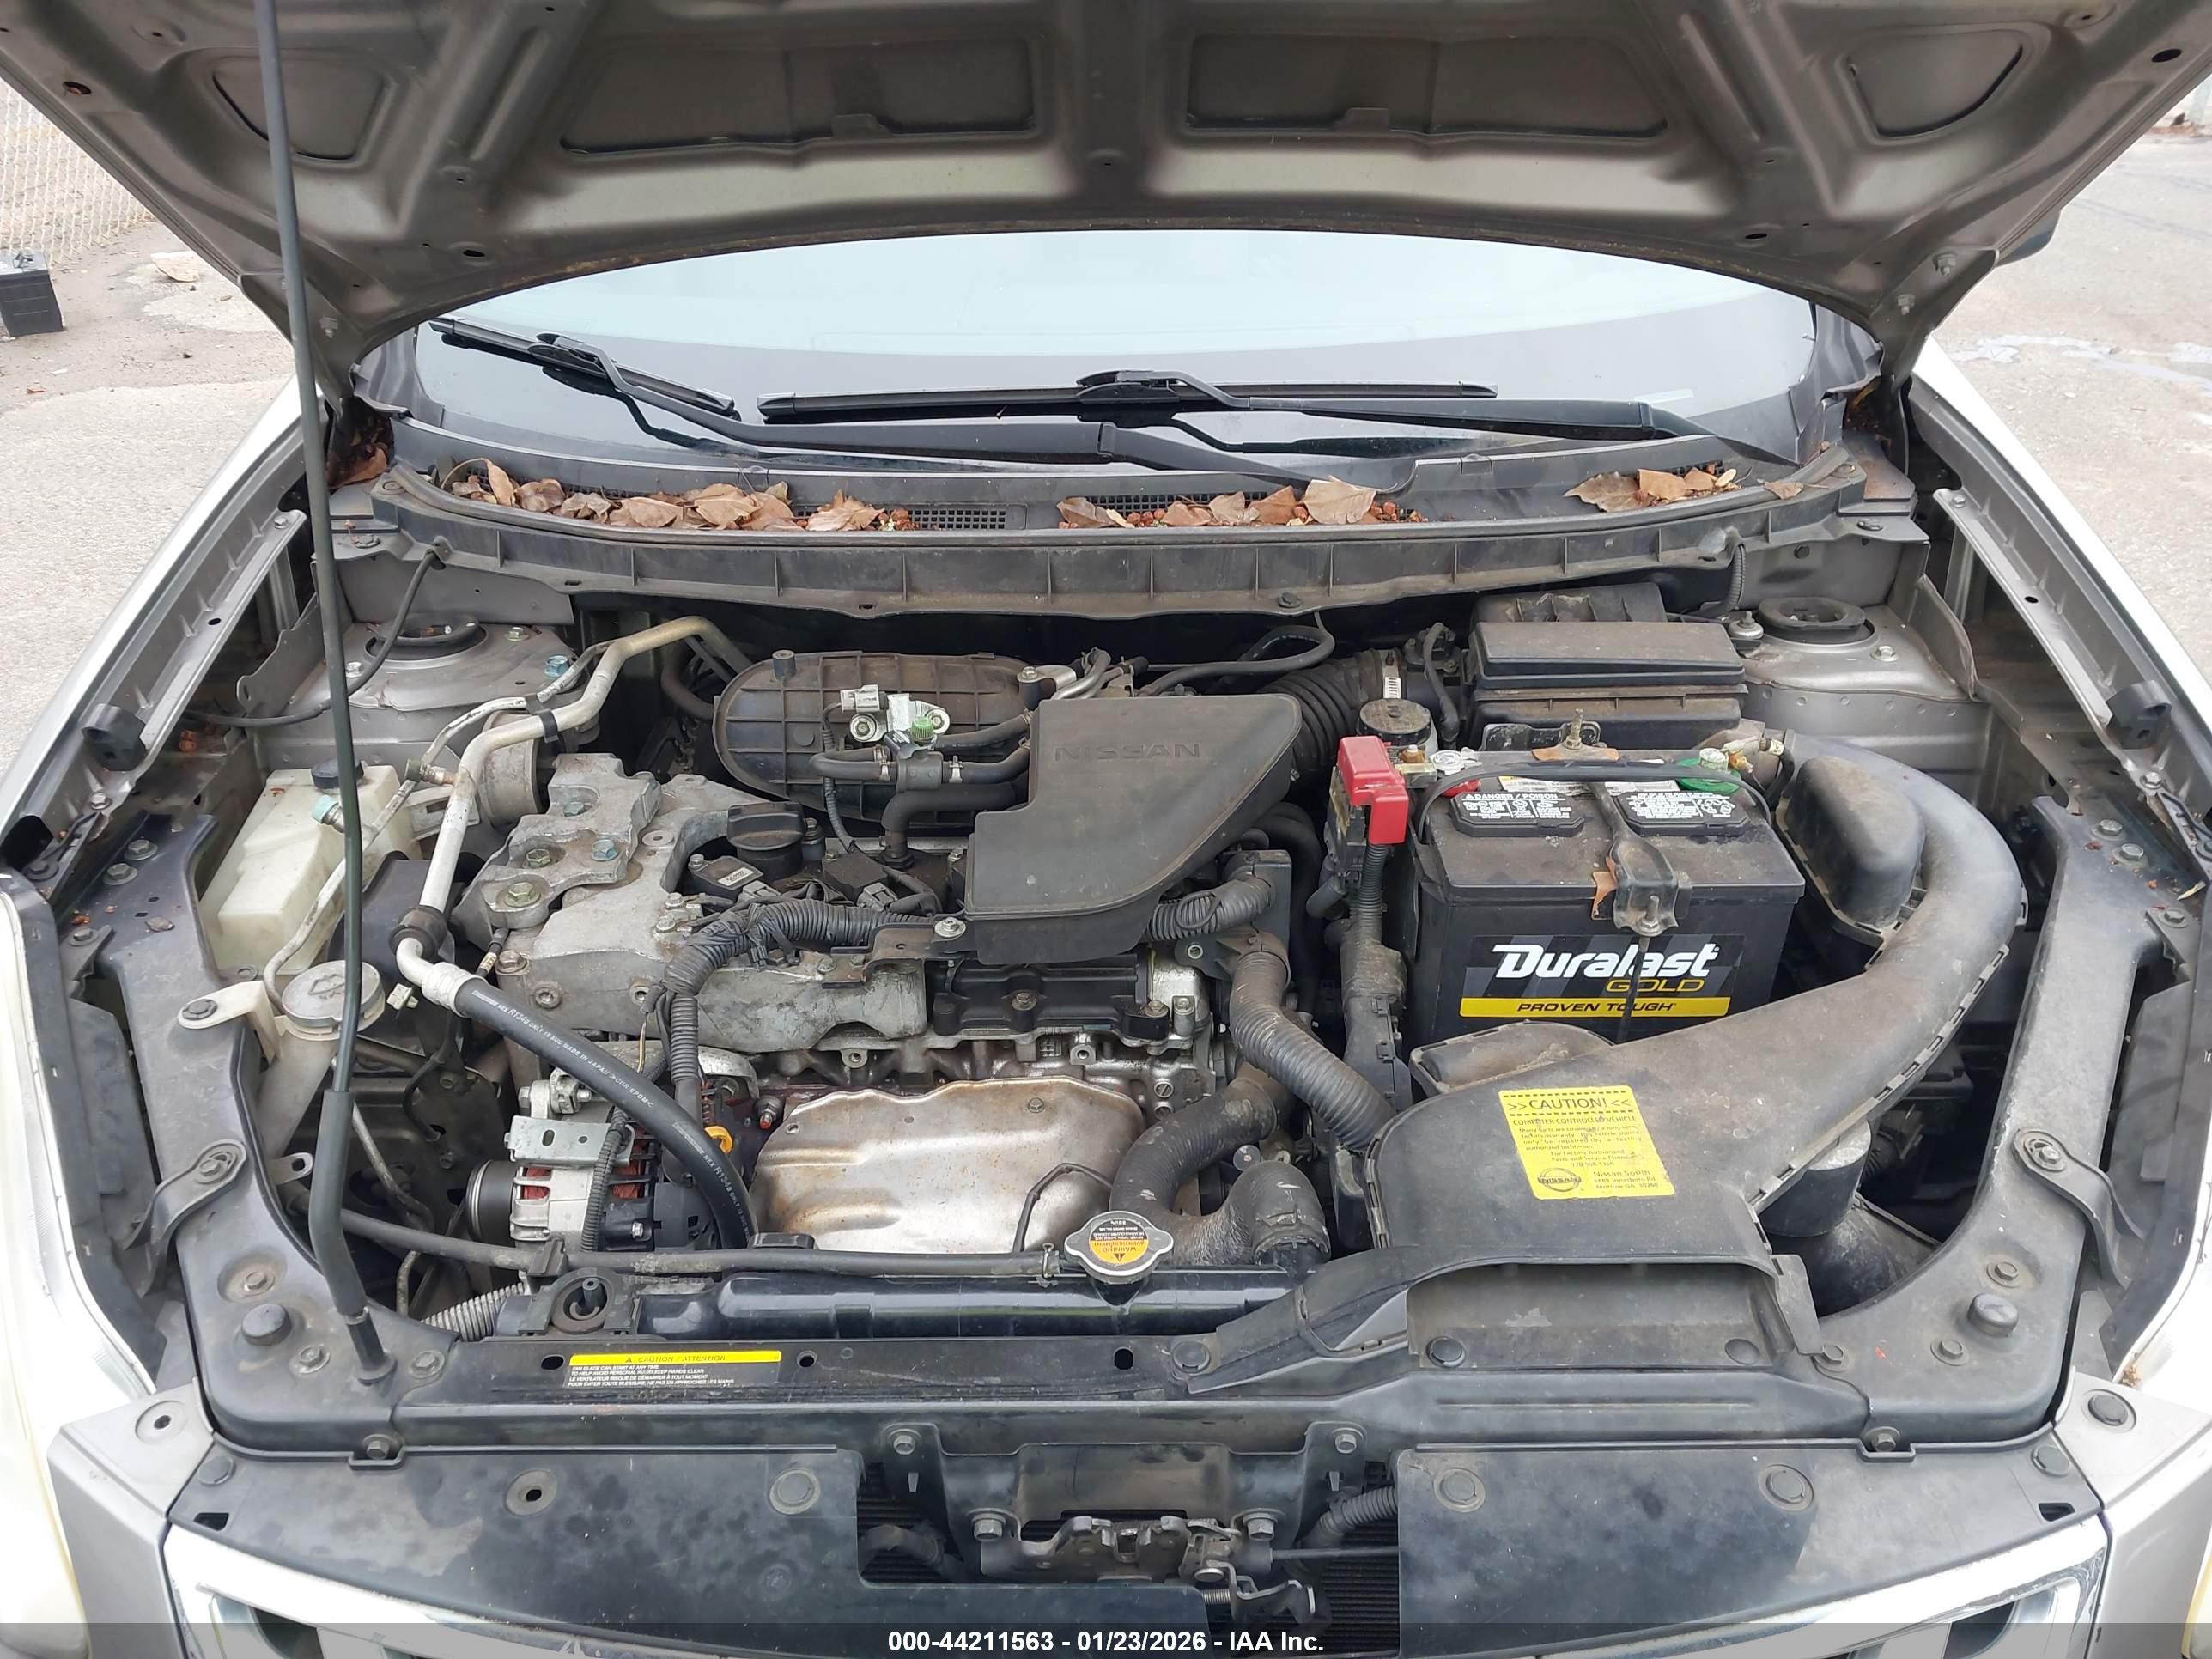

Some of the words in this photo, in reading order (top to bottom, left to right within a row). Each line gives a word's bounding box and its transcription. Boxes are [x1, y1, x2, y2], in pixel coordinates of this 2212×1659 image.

[1054, 742, 1201, 762] NISSAN
[1492, 943, 1718, 978] Duralast
[1606, 979, 1705, 992] GOLD
[1517, 1002, 1598, 1012] PROVEN
[562, 1042, 581, 1056] MADE
[588, 1058, 609, 1075] JAPAN
[1529, 1097, 1607, 1110] CAUTION!
